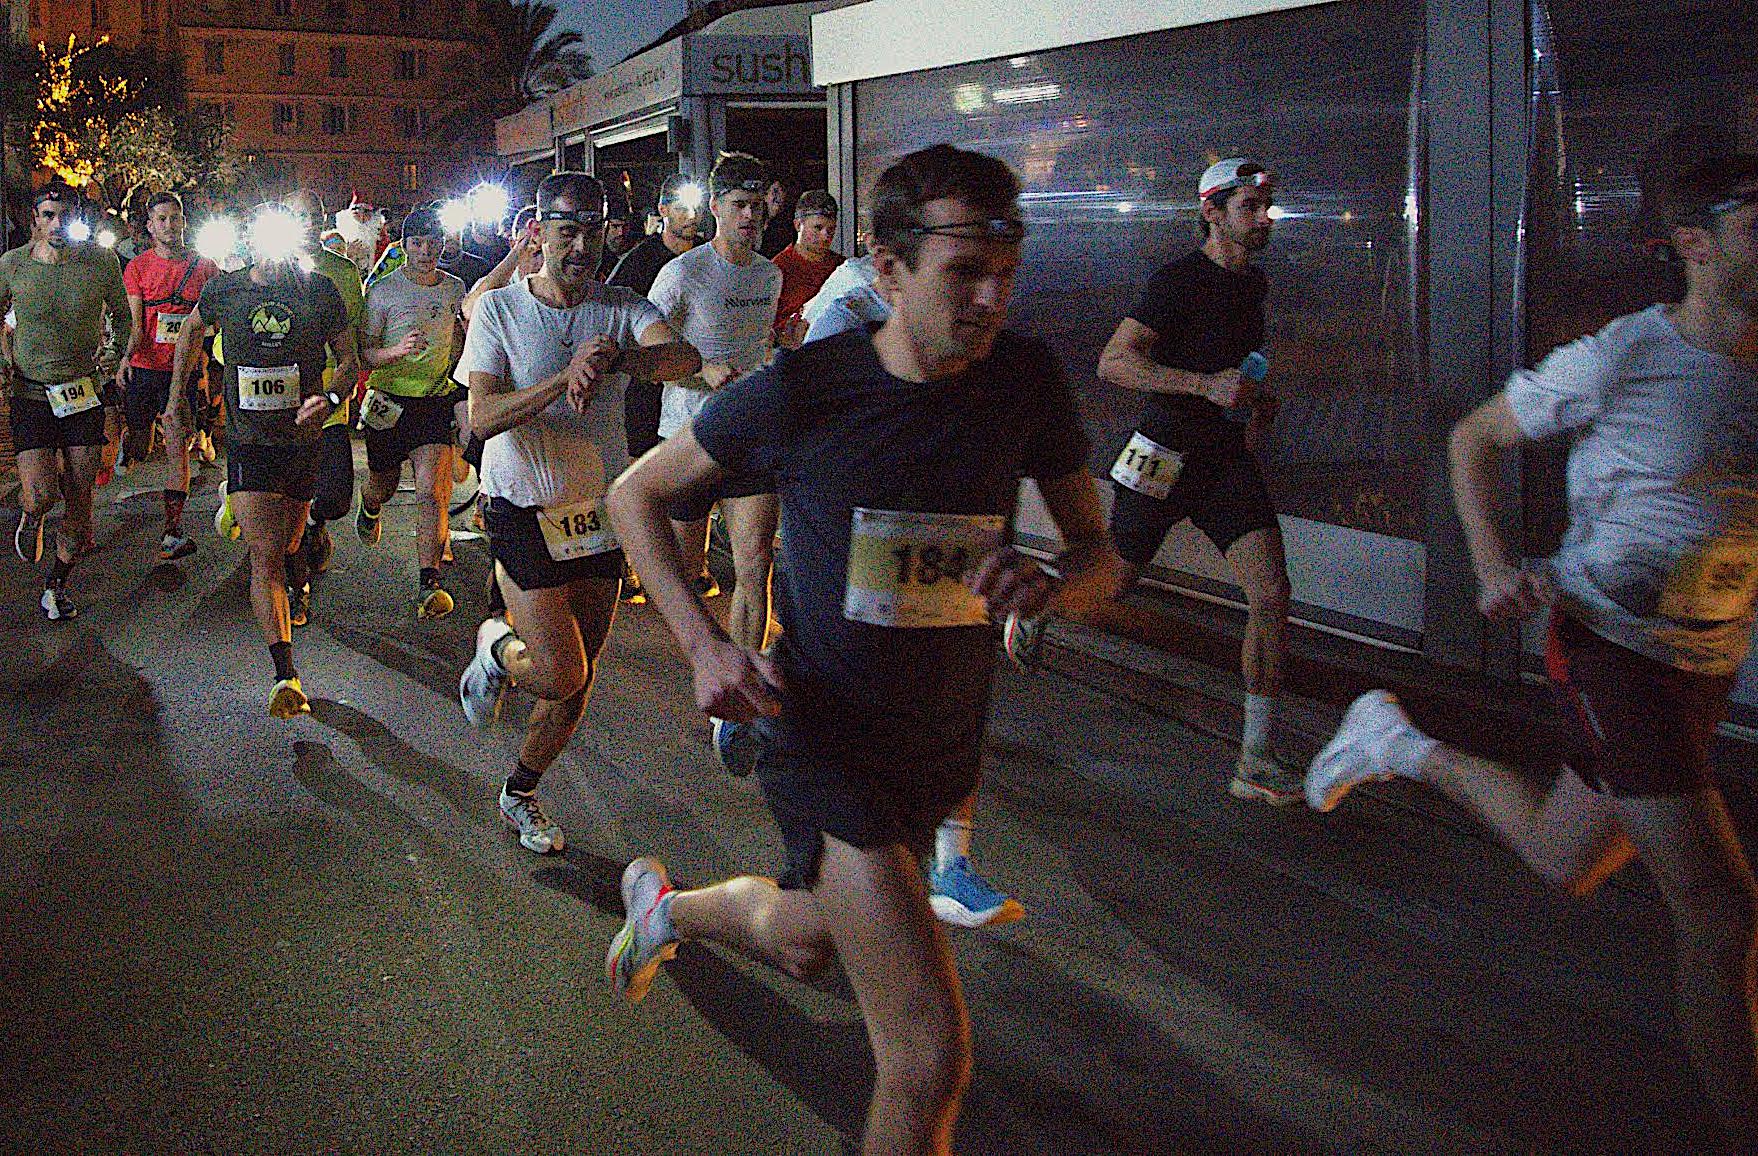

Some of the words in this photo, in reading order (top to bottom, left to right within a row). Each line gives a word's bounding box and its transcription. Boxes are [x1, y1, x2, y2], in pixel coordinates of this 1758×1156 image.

[60, 384, 85, 402] 194
[250, 379, 284, 395] 106
[1126, 448, 1162, 478] 111
[560, 510, 601, 537] 183
